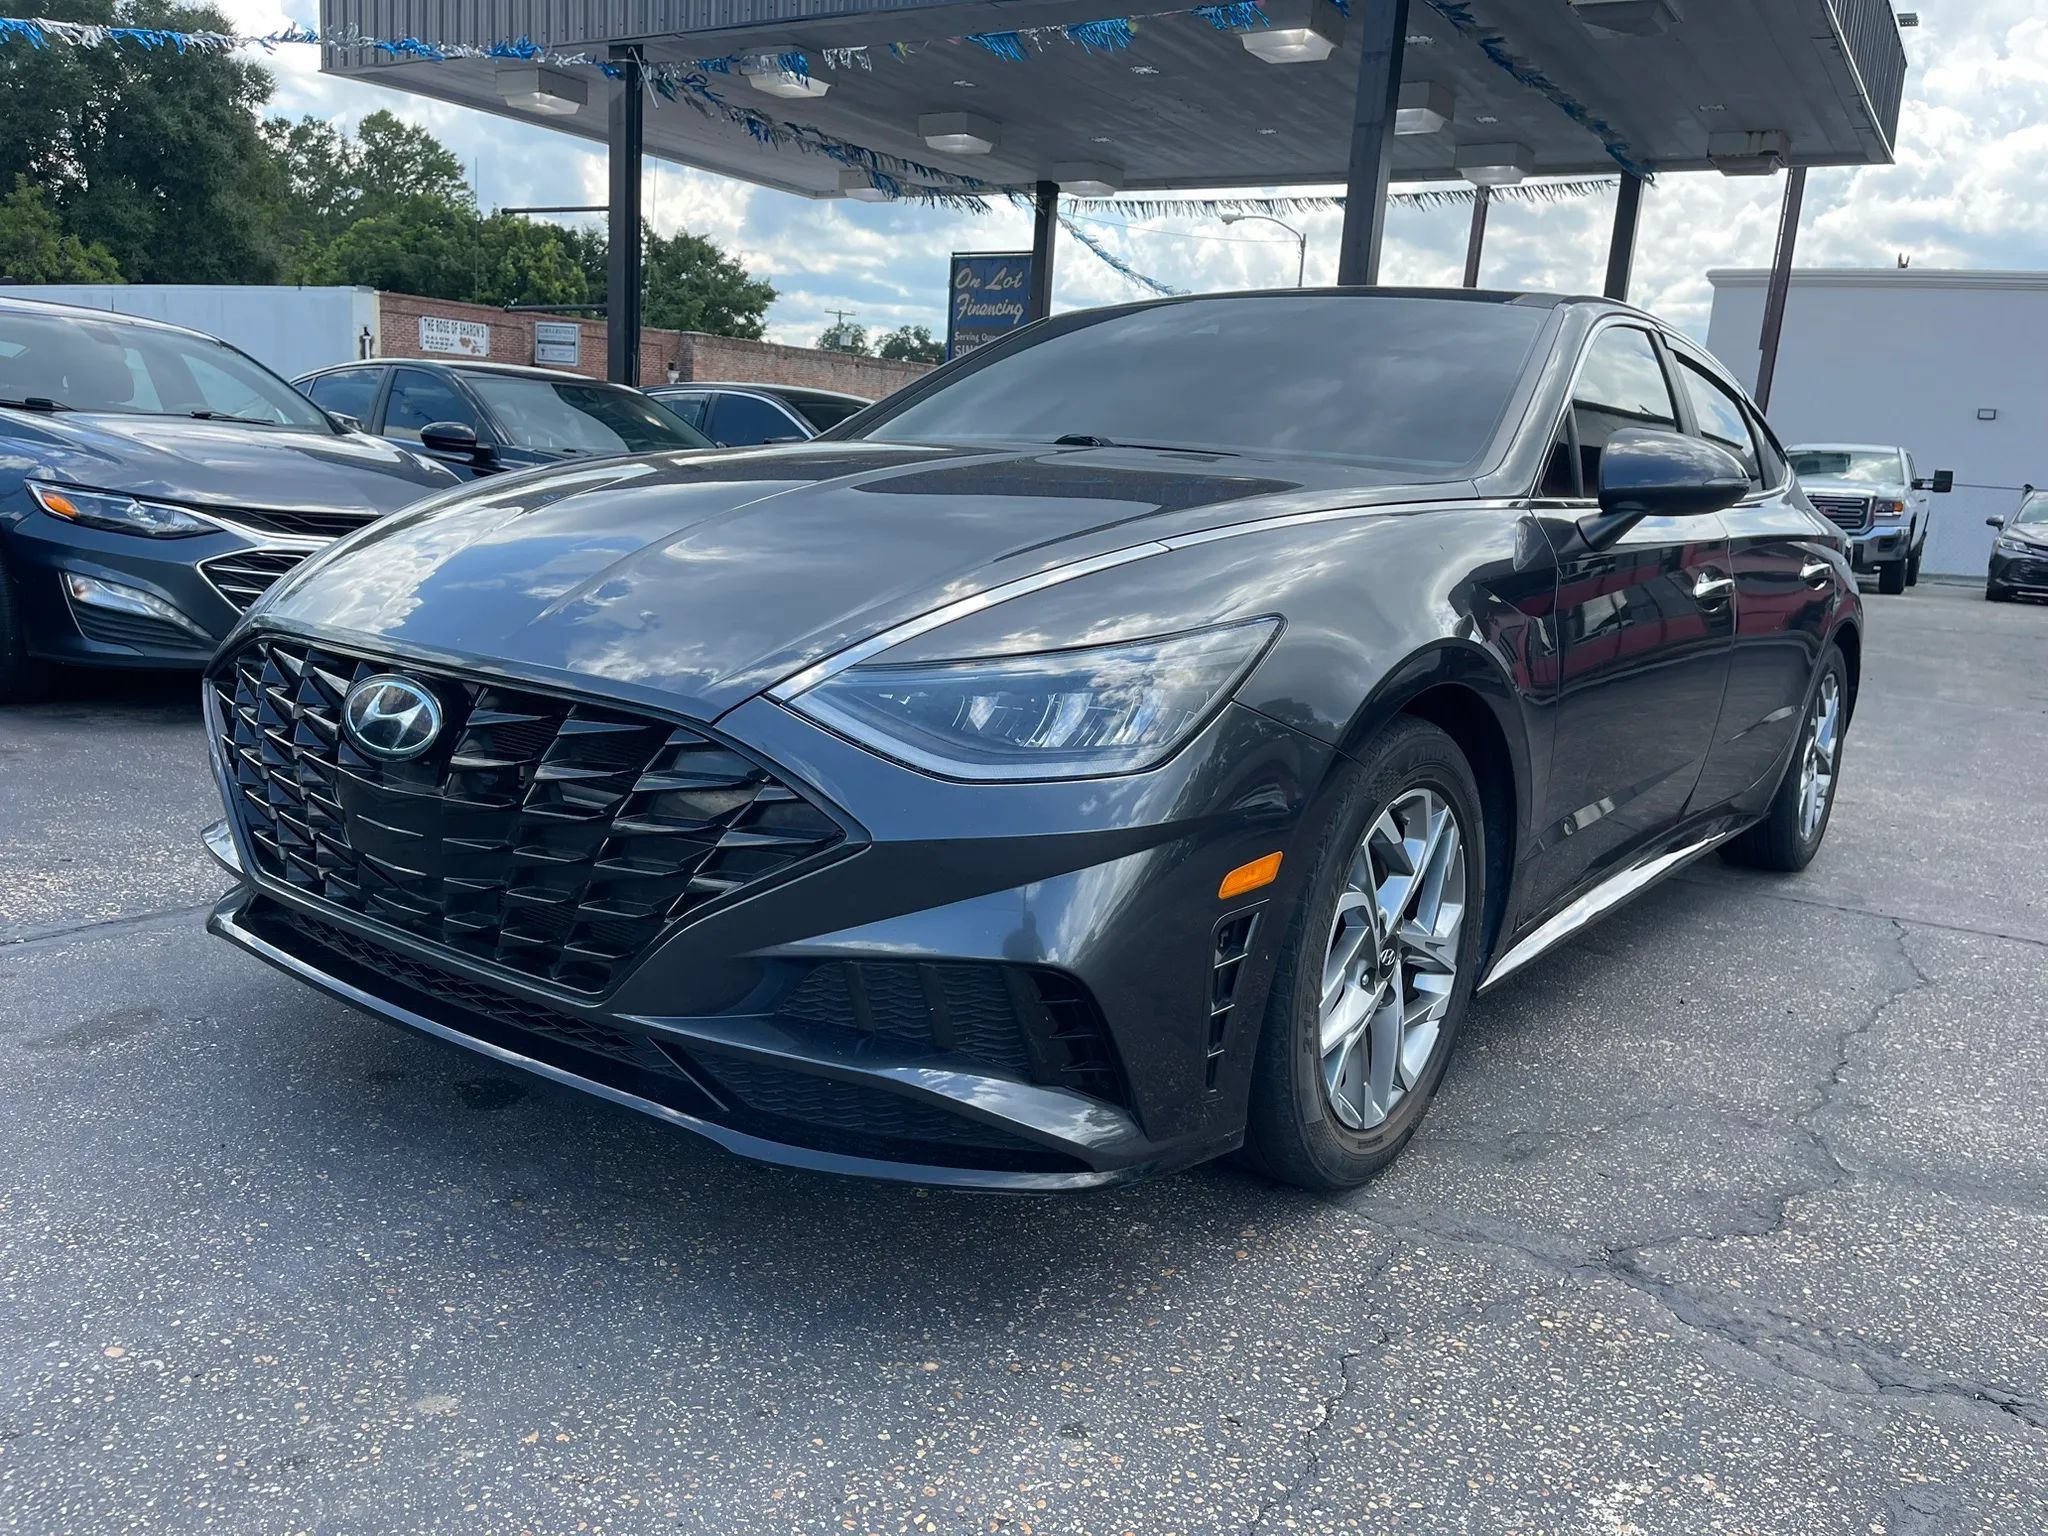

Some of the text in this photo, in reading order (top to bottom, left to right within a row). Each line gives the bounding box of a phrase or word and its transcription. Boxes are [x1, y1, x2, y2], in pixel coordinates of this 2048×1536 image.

[955, 266, 1023, 291] On Lot
[957, 293, 1024, 325] Financing
[424, 318, 435, 333] THE
[436, 320, 450, 335] ROSE
[451, 322, 459, 336] OF
[954, 331, 979, 343] Serving
